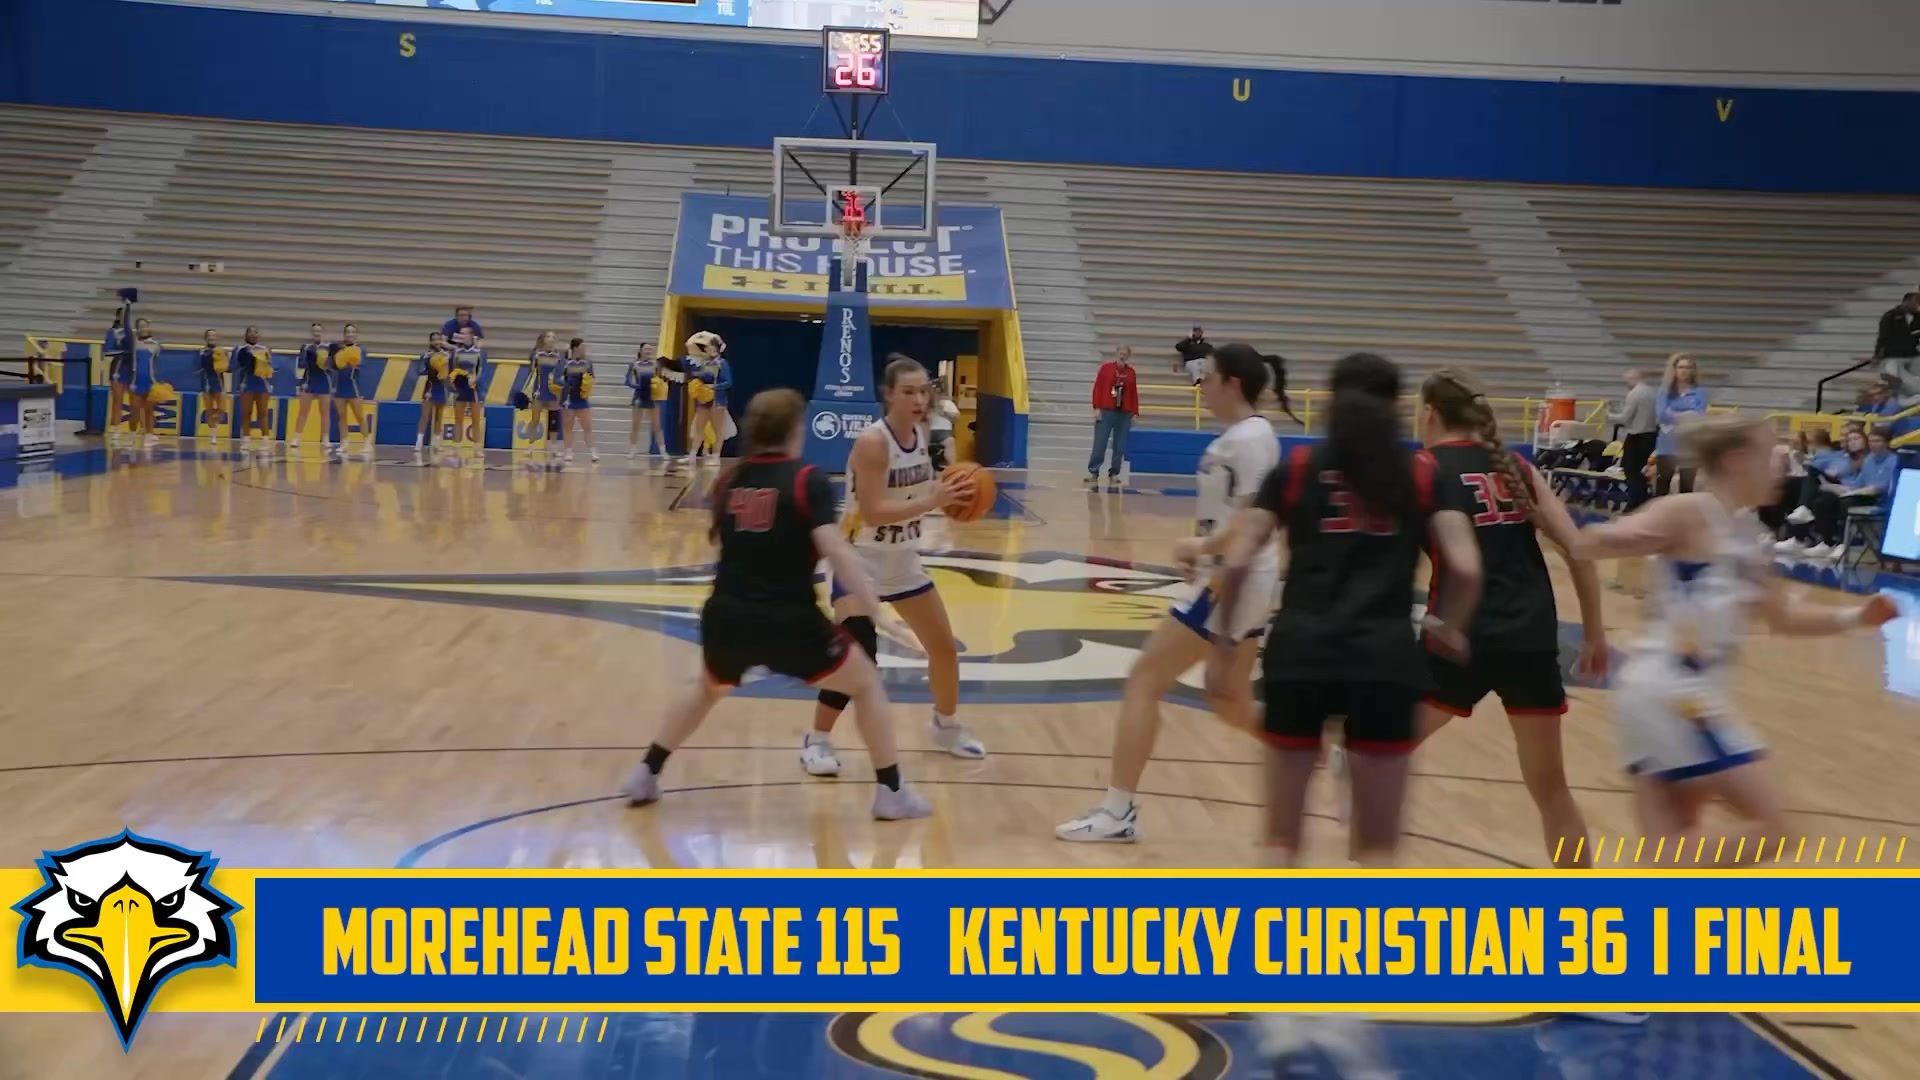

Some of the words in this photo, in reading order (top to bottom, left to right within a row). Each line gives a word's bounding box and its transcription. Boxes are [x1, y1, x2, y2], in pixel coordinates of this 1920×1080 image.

[399, 32, 417, 57] S
[834, 53, 876, 86] 26
[1232, 78, 1251, 102] U
[1716, 98, 1733, 122] V
[706, 243, 802, 273] THIS
[839, 307, 857, 384] RENOS
[728, 487, 780, 533] 40
[1318, 469, 1400, 536] 3
[1460, 472, 1528, 527] 35
